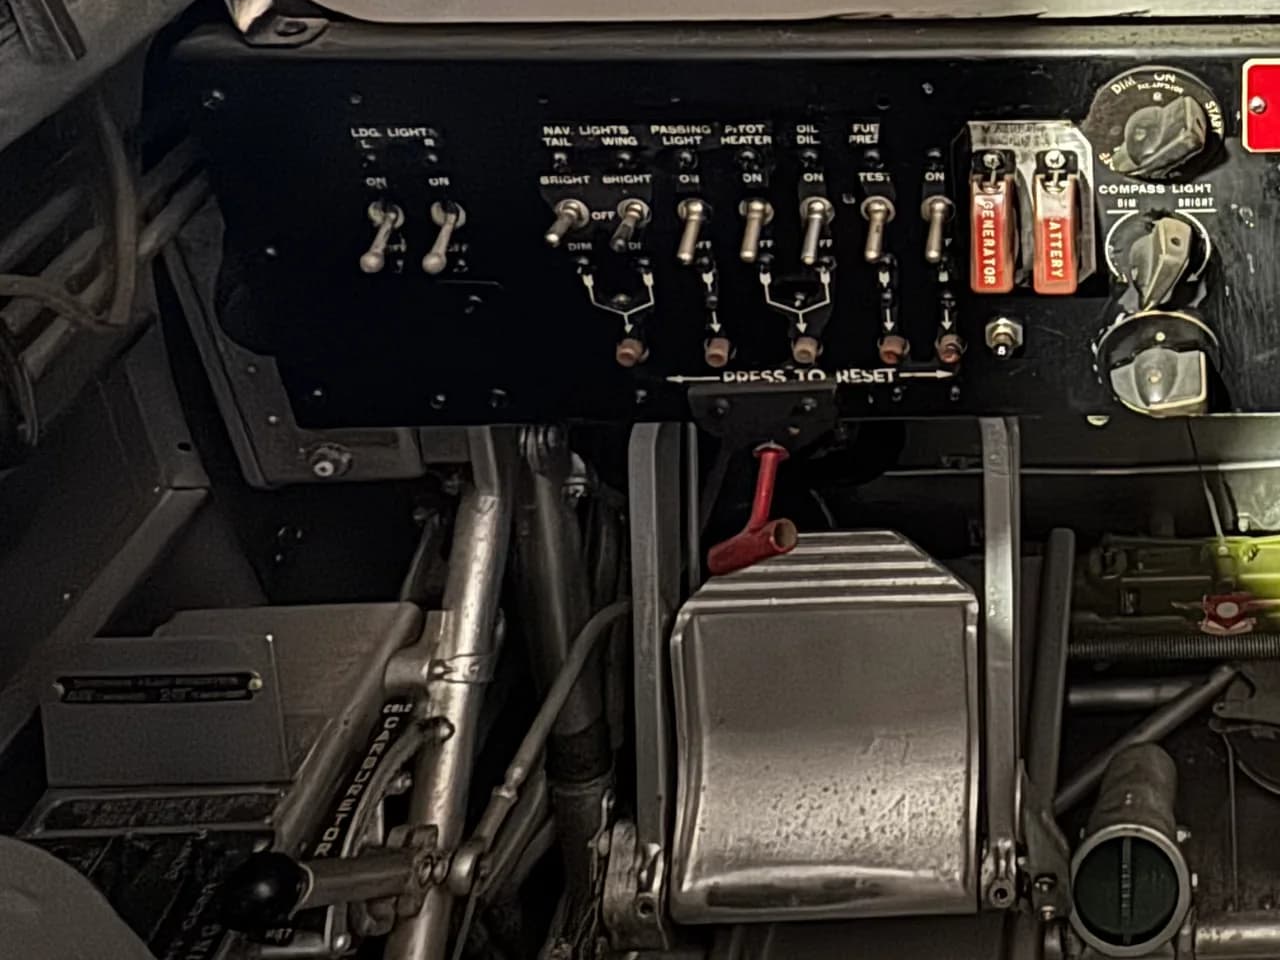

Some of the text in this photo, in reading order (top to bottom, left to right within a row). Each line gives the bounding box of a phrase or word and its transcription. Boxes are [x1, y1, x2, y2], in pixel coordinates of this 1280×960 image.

[1111, 77, 1137, 95] DIM
[578, 125, 630, 135] LIGHTS
[650, 124, 712, 135] PASSING
[600, 137, 639, 146] WING
[662, 136, 703, 146] LIGHT
[720, 135, 773, 145] HEATER
[803, 172, 824, 183] ON
[925, 172, 945, 182] ON
[1098, 183, 1213, 194] COMPASS LIGHT
[1178, 197, 1215, 208] BRIGHT
[981, 200, 997, 286] GENERATOR
[836, 368, 897, 384] RESET
[313, 717, 400, 858] CARBURETOR
